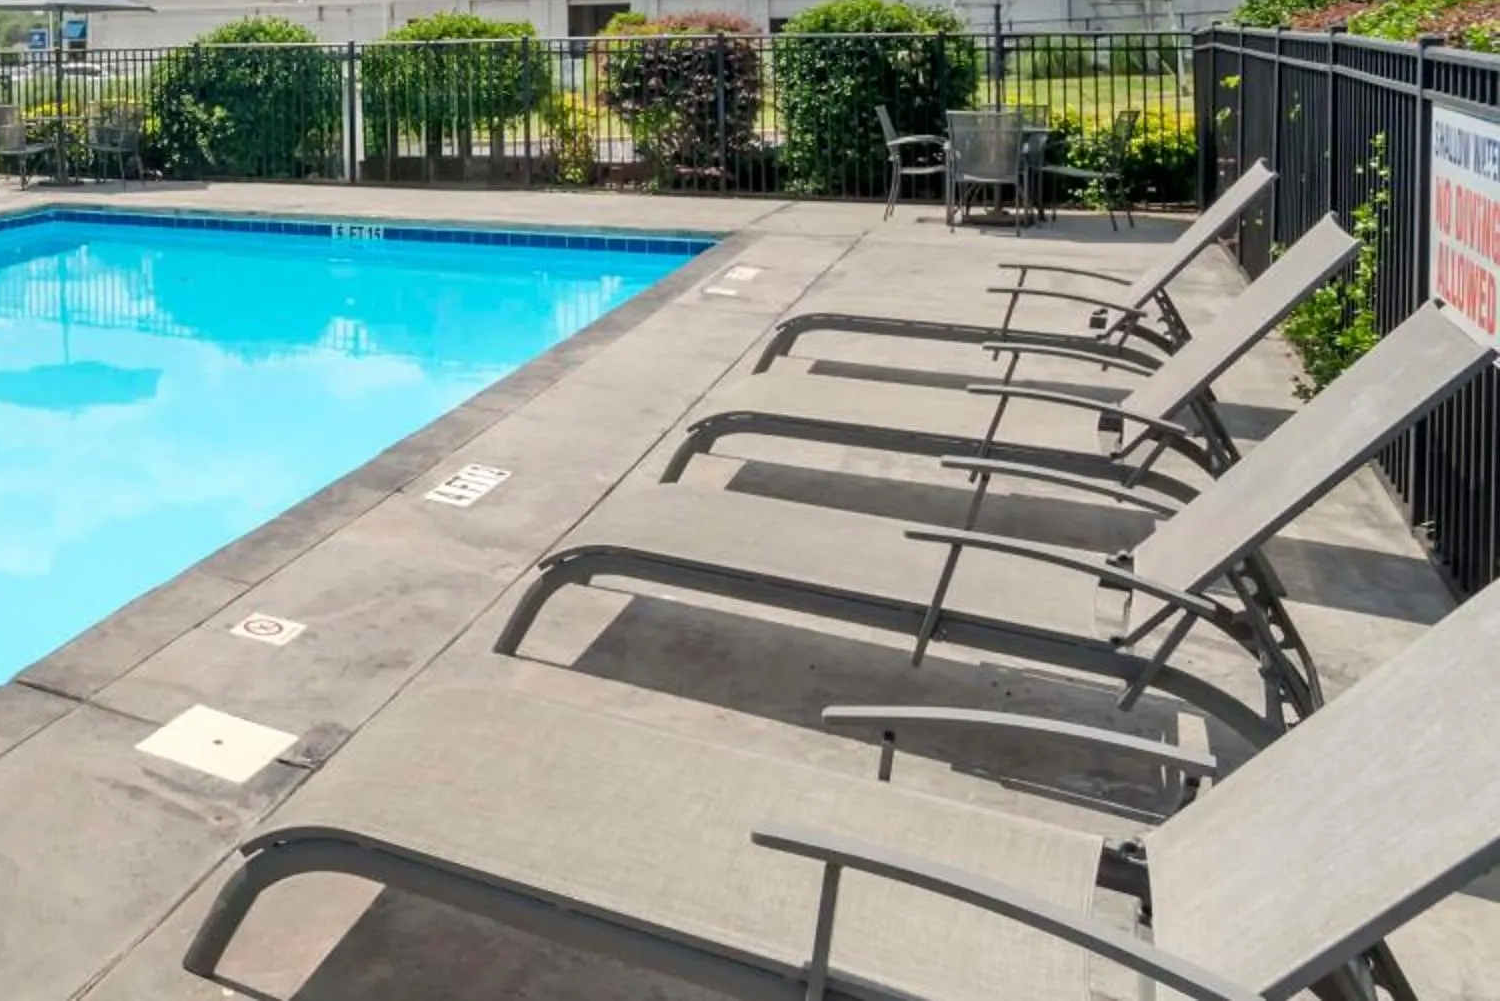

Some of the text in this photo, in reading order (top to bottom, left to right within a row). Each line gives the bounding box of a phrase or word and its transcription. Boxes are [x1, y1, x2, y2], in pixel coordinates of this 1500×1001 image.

[1435, 119, 1470, 170] SHALLOW
[1435, 175, 1451, 236] NO
[1437, 240, 1496, 336] ALLOWED
